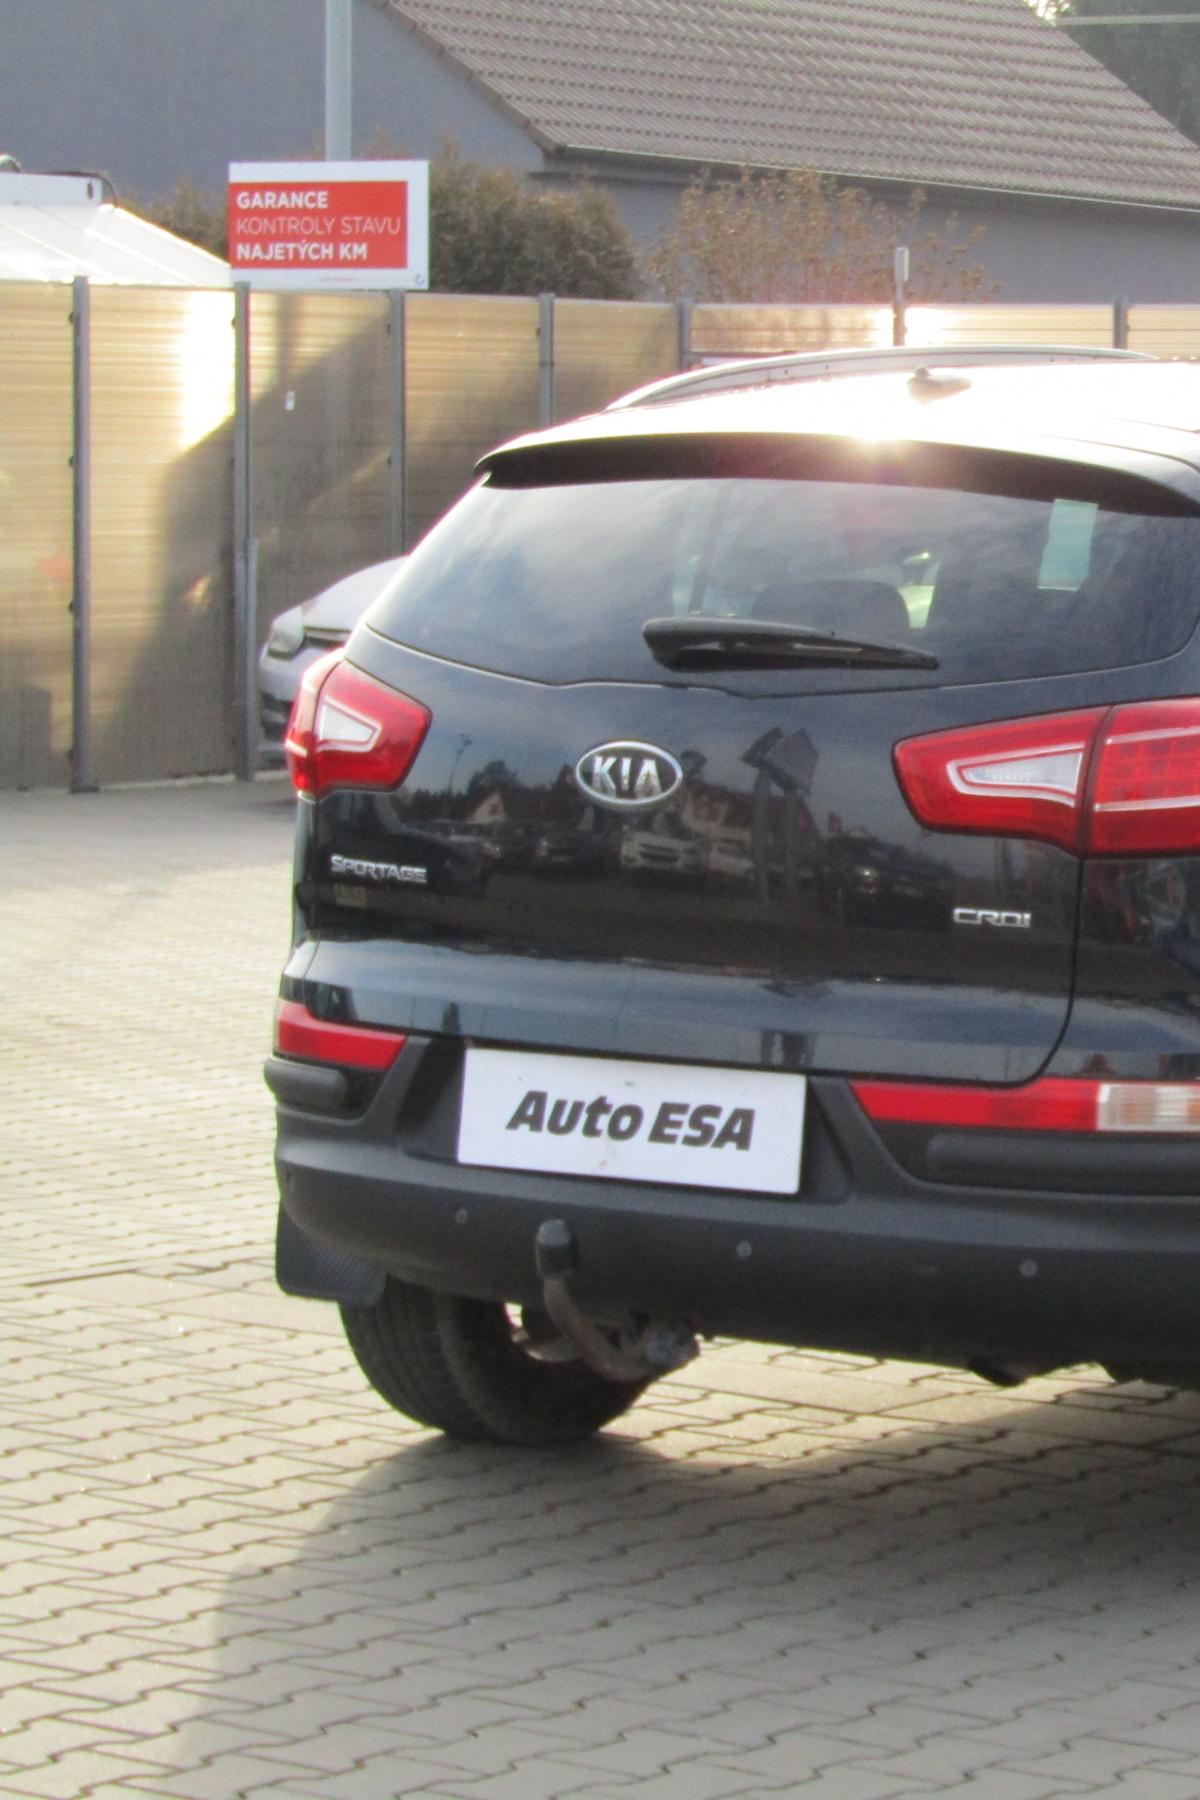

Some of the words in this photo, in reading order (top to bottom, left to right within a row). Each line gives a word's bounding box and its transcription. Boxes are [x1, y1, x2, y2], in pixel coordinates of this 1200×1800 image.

[236, 191, 328, 209] GARANCE
[236, 217, 335, 235] KONTROLY
[341, 216, 400, 235] STAVU
[237, 239, 333, 260] NAJETÝCH
[339, 243, 367, 260] KM
[593, 755, 661, 799] KIA
[330, 853, 428, 883] SPORTAGE
[505, 1090, 645, 1141] Auto
[647, 1102, 755, 1151] ESA
